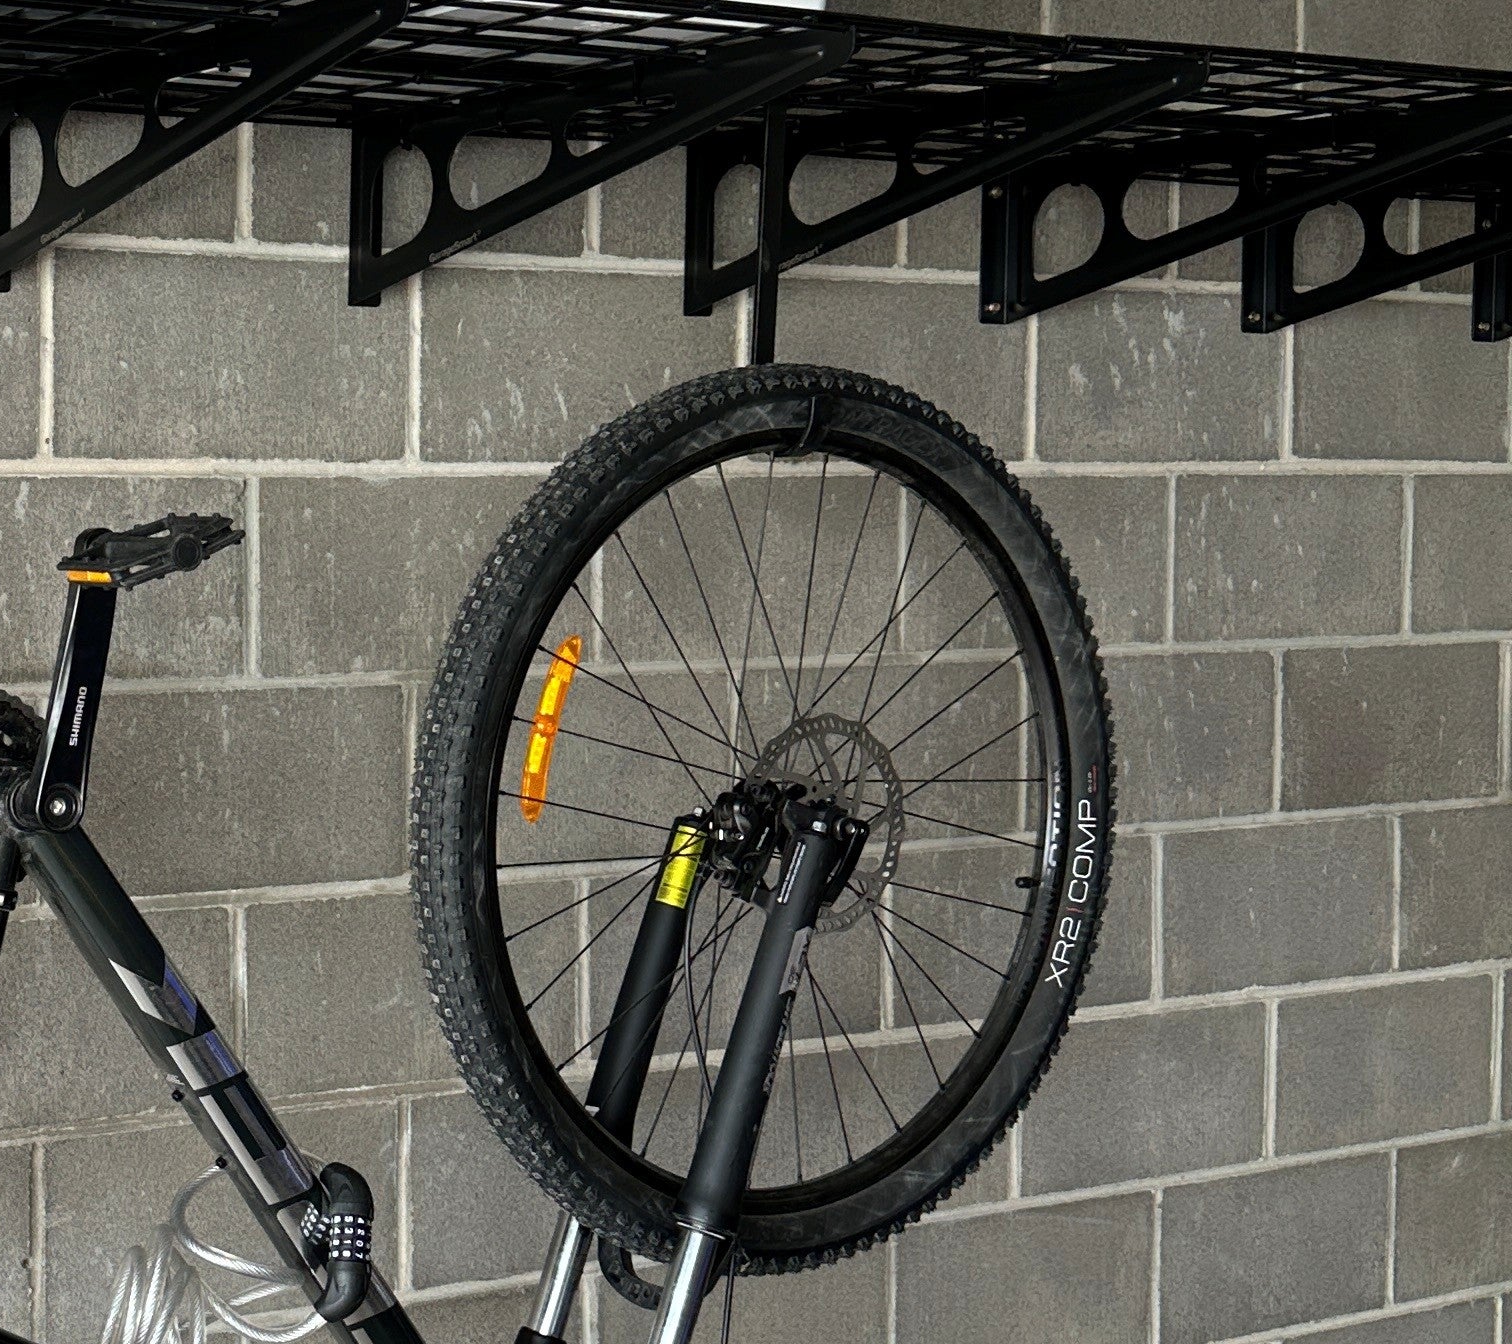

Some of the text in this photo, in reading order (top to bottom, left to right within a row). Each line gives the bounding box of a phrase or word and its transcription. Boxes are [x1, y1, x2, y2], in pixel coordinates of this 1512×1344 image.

[68, 686, 88, 746] SHIMANO
[1044, 798, 1097, 988] XR2 COMP
